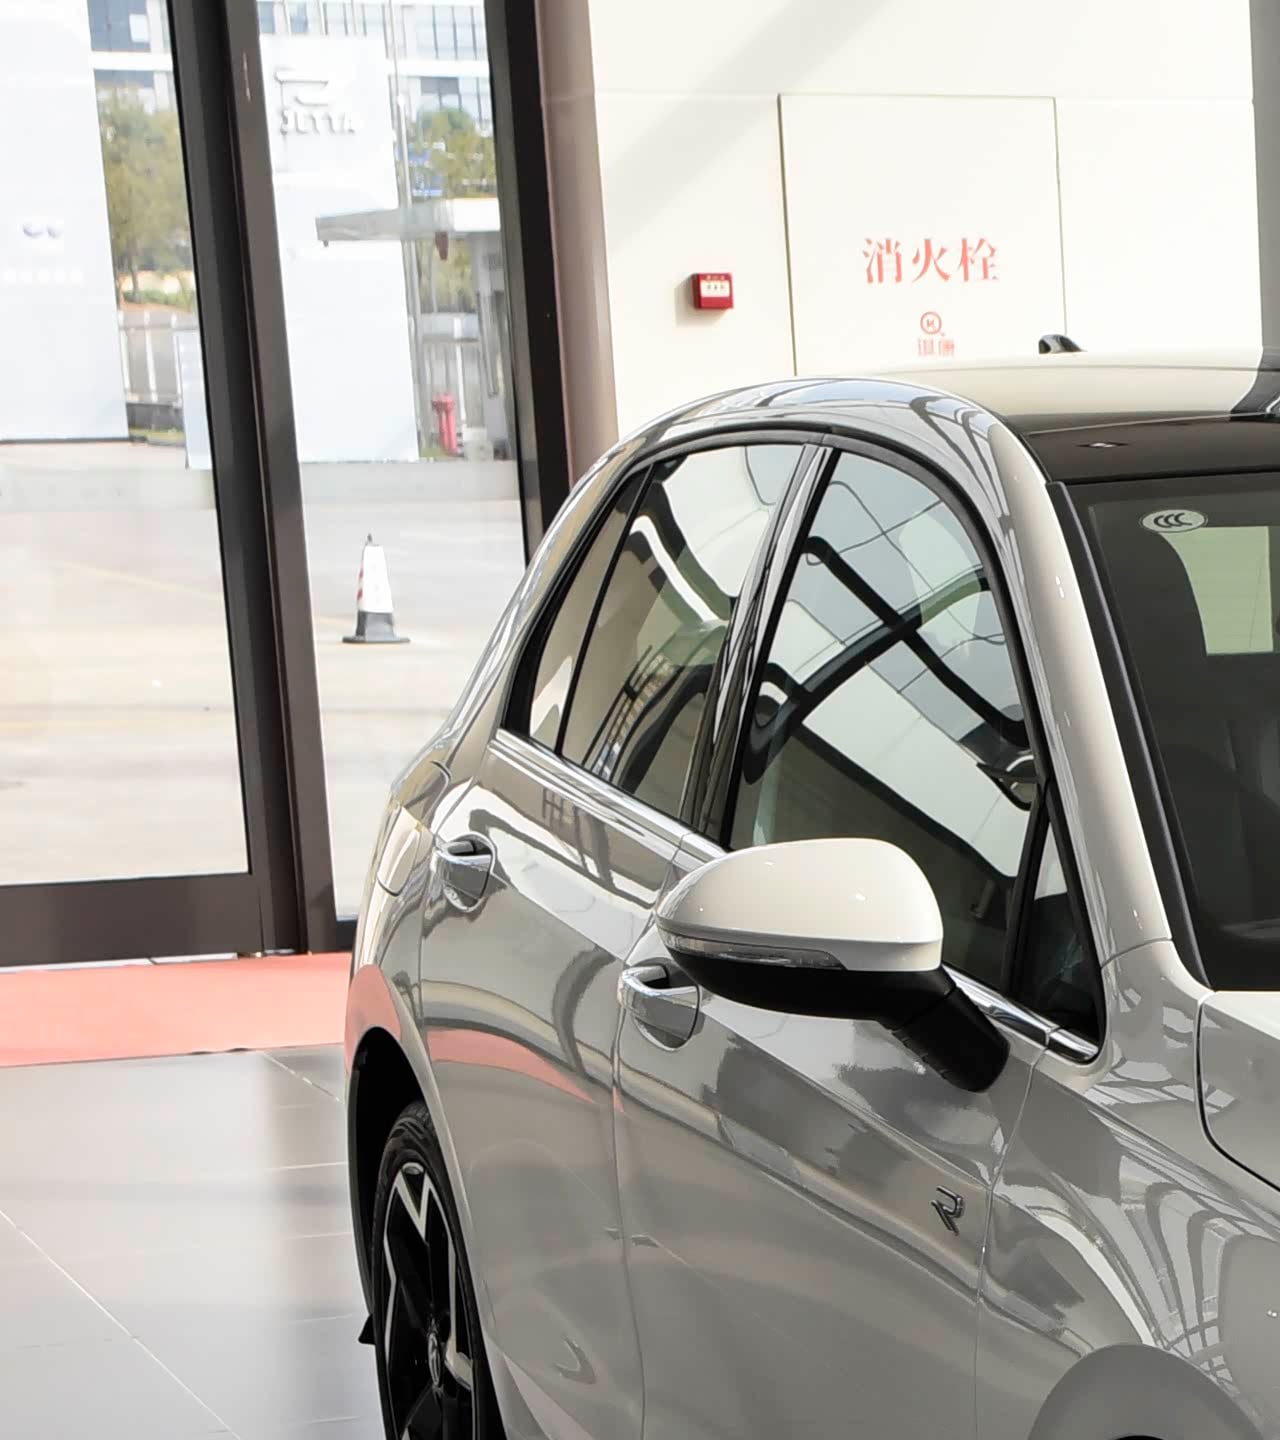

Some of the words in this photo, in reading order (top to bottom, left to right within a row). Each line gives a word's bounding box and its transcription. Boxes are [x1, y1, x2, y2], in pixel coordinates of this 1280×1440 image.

[862, 237, 1000, 284] 消火栓
[931, 1185, 963, 1235] R
